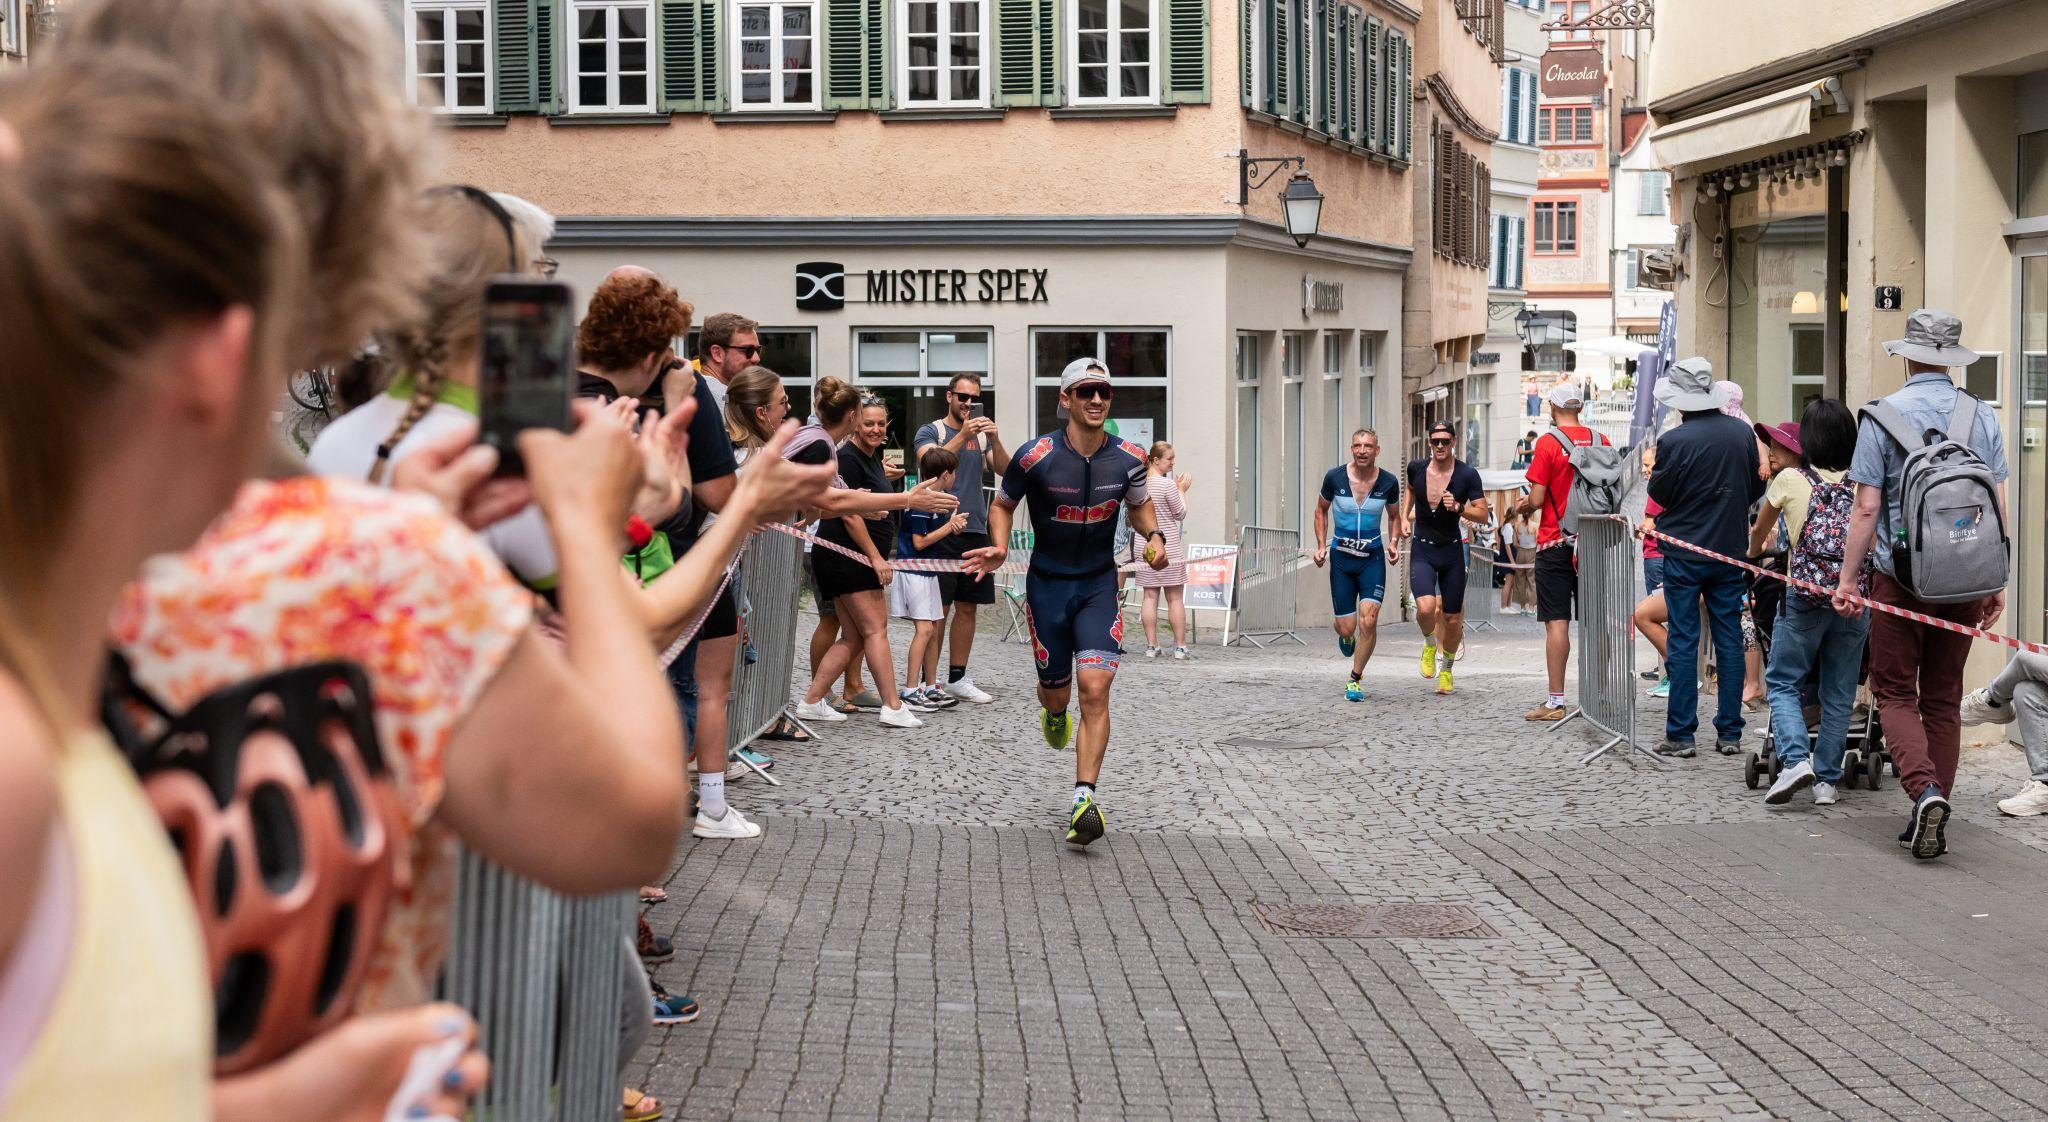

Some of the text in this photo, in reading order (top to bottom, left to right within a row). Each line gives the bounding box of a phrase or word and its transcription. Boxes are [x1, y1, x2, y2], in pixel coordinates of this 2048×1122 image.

[1545, 63, 1599, 82] Chocolat
[866, 268, 1048, 303] MISTER SPEX
[1883, 297, 1893, 309] 9
[1342, 539, 1368, 551] 3217
[1193, 591, 1223, 599] KOST
